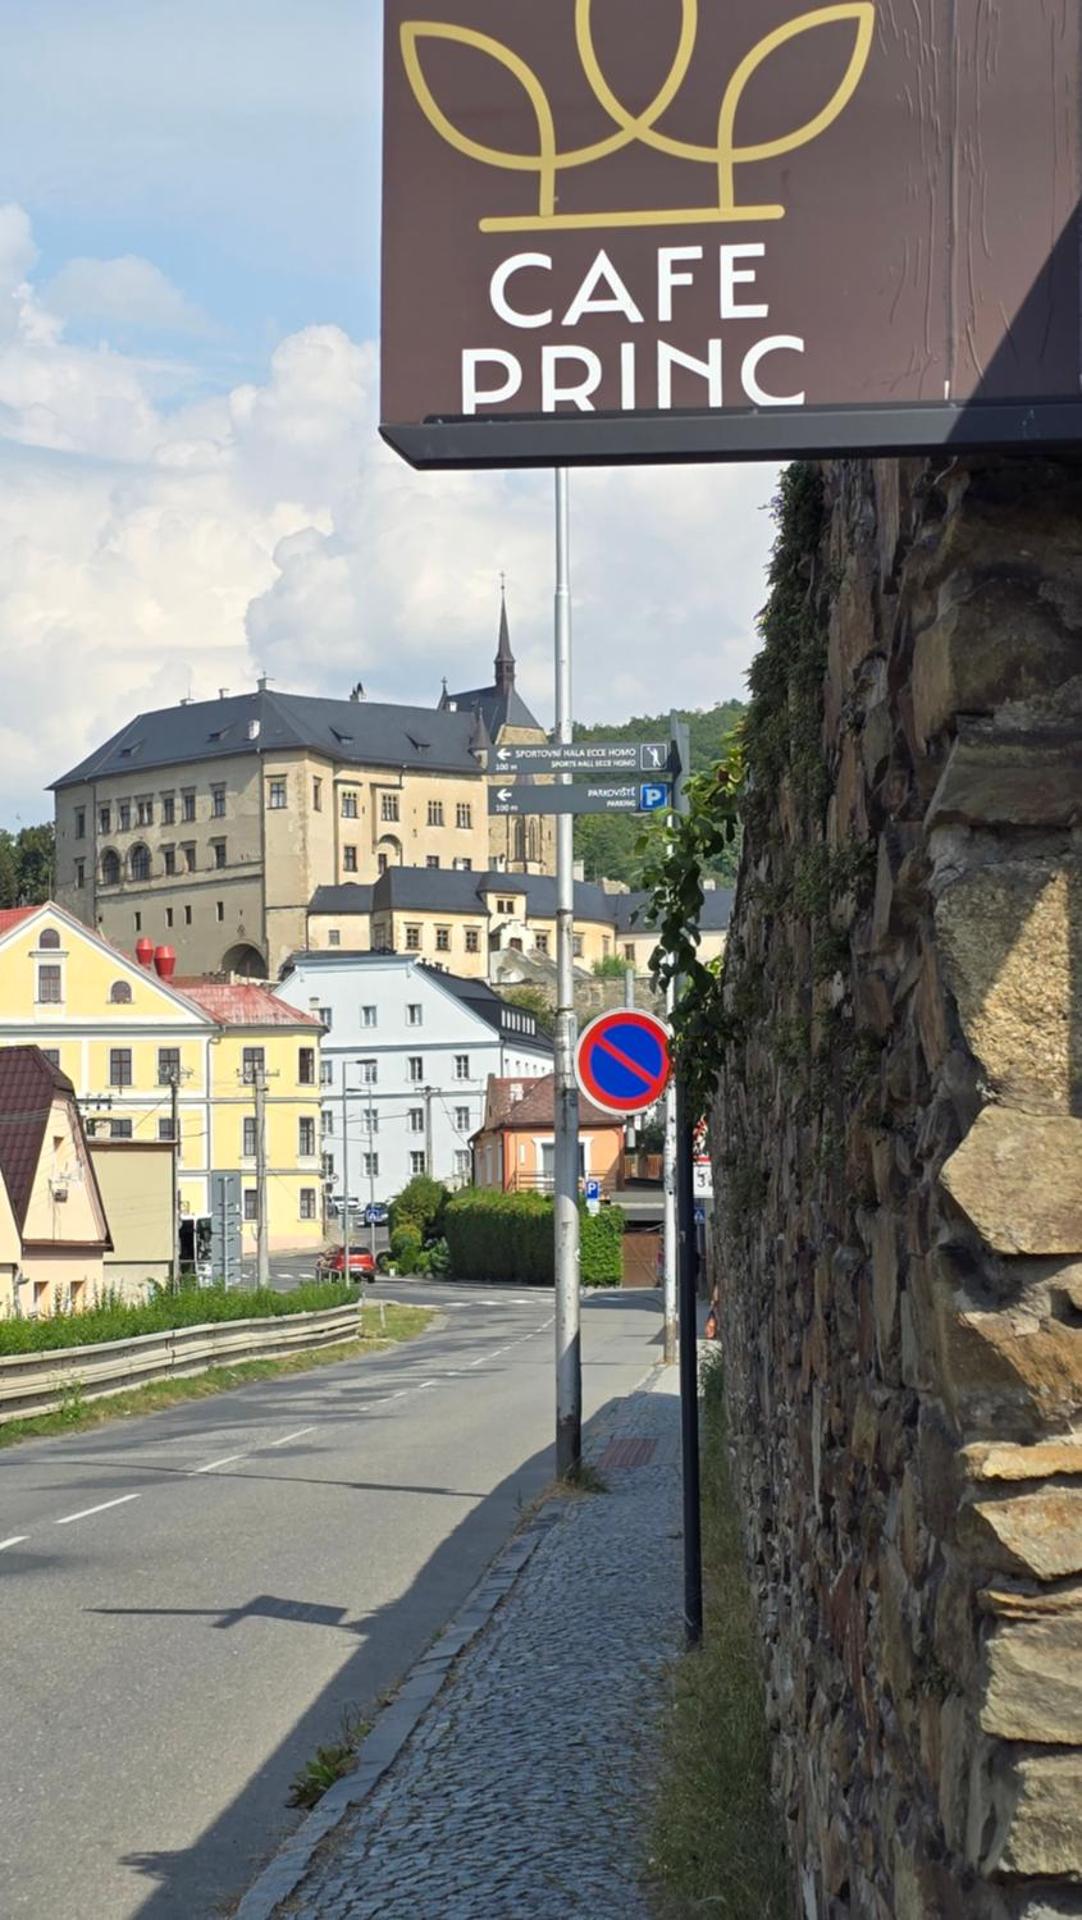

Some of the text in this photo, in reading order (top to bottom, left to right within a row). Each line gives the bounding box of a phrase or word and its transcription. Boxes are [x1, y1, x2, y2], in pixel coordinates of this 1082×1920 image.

[489, 243, 769, 329] CAFE
[461, 335, 806, 416] PRINC
[515, 748, 636, 759] SPORTOVNÍ HALA ECCE HOMO
[551, 760, 576, 768] SPORTS
[577, 760, 593, 768] HALL
[595, 760, 611, 768] ECCE
[645, 788, 661, 805] P
[607, 800, 636, 808] PARKING
